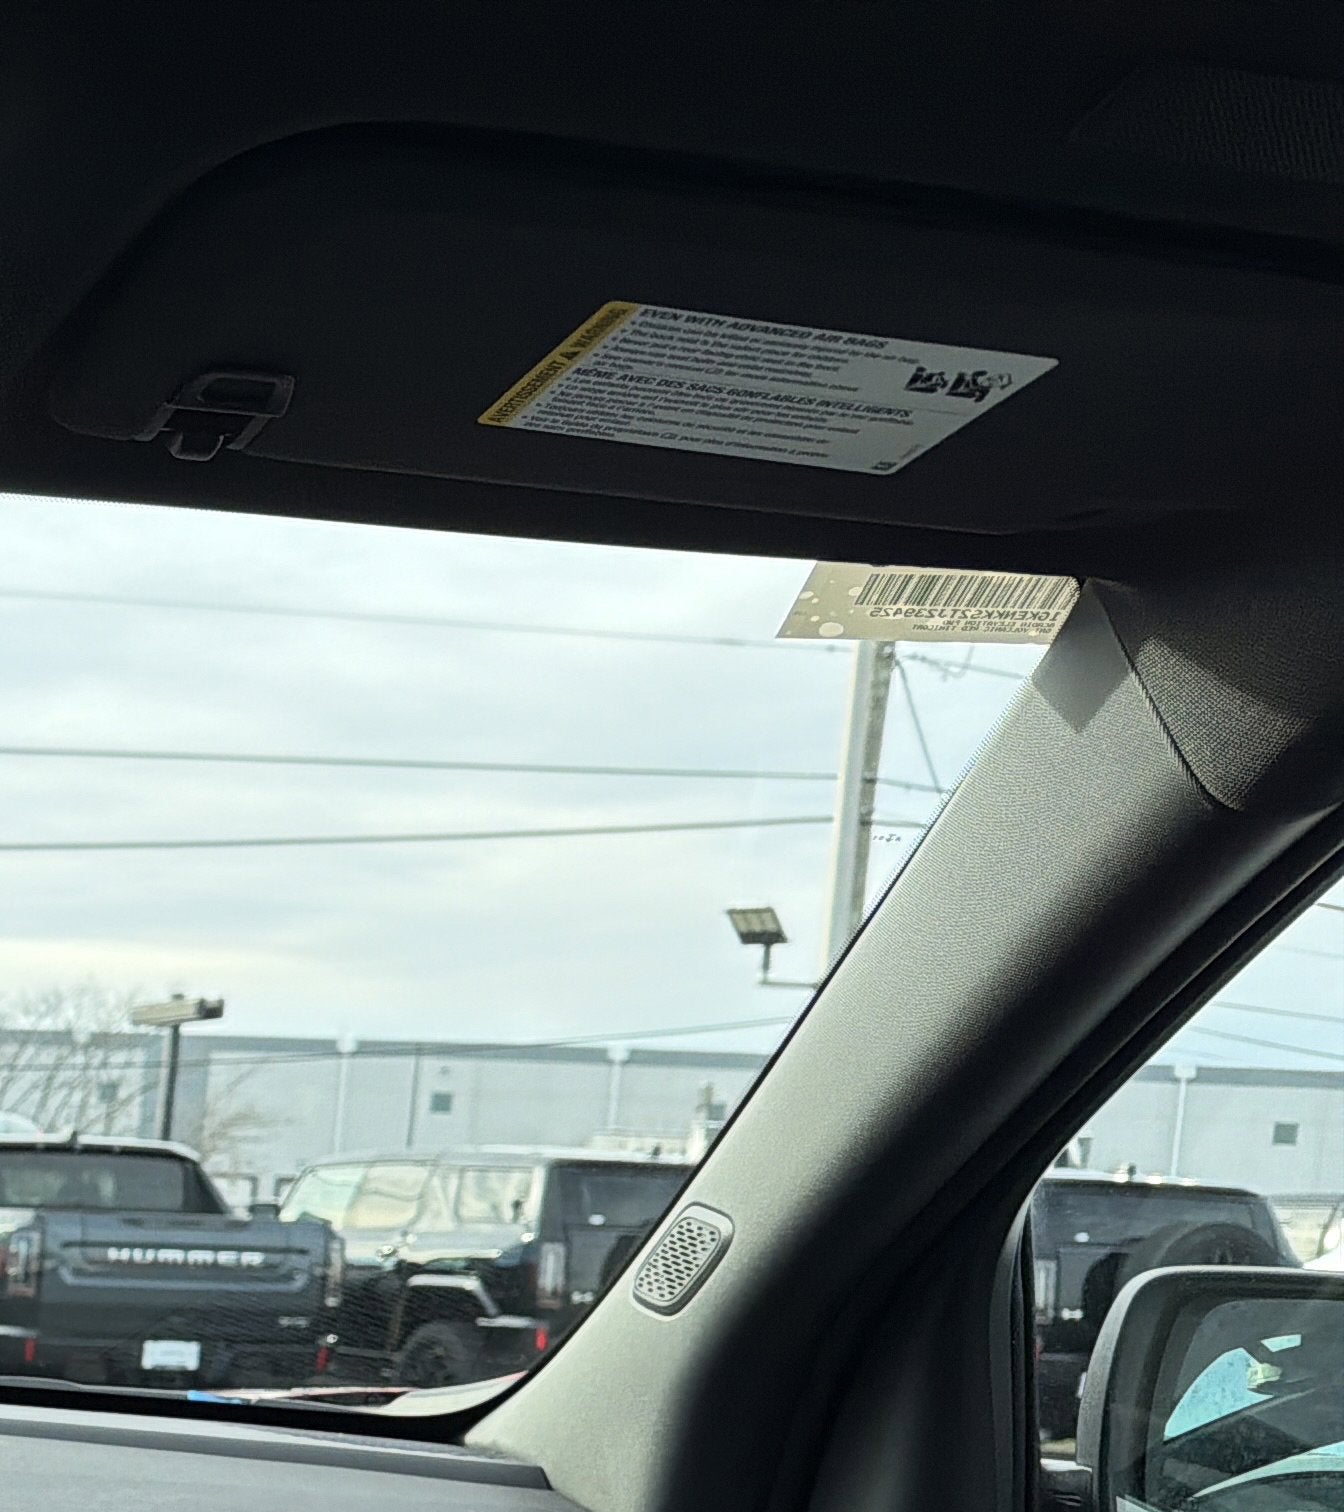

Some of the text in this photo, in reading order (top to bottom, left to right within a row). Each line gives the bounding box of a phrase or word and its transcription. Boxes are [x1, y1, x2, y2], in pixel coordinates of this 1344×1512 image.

[639, 309, 889, 349] EVEN WITH ADVANCED AIR BAGS
[487, 360, 567, 423] AVERTISSEMENT
[616, 374, 658, 386] AVEC
[655, 379, 688, 389] DES
[686, 382, 725, 394] SACS
[726, 388, 817, 405] GONFLABLES
[815, 400, 912, 417] INTELLIGENTS
[106, 1246, 266, 1267] HUMMER
